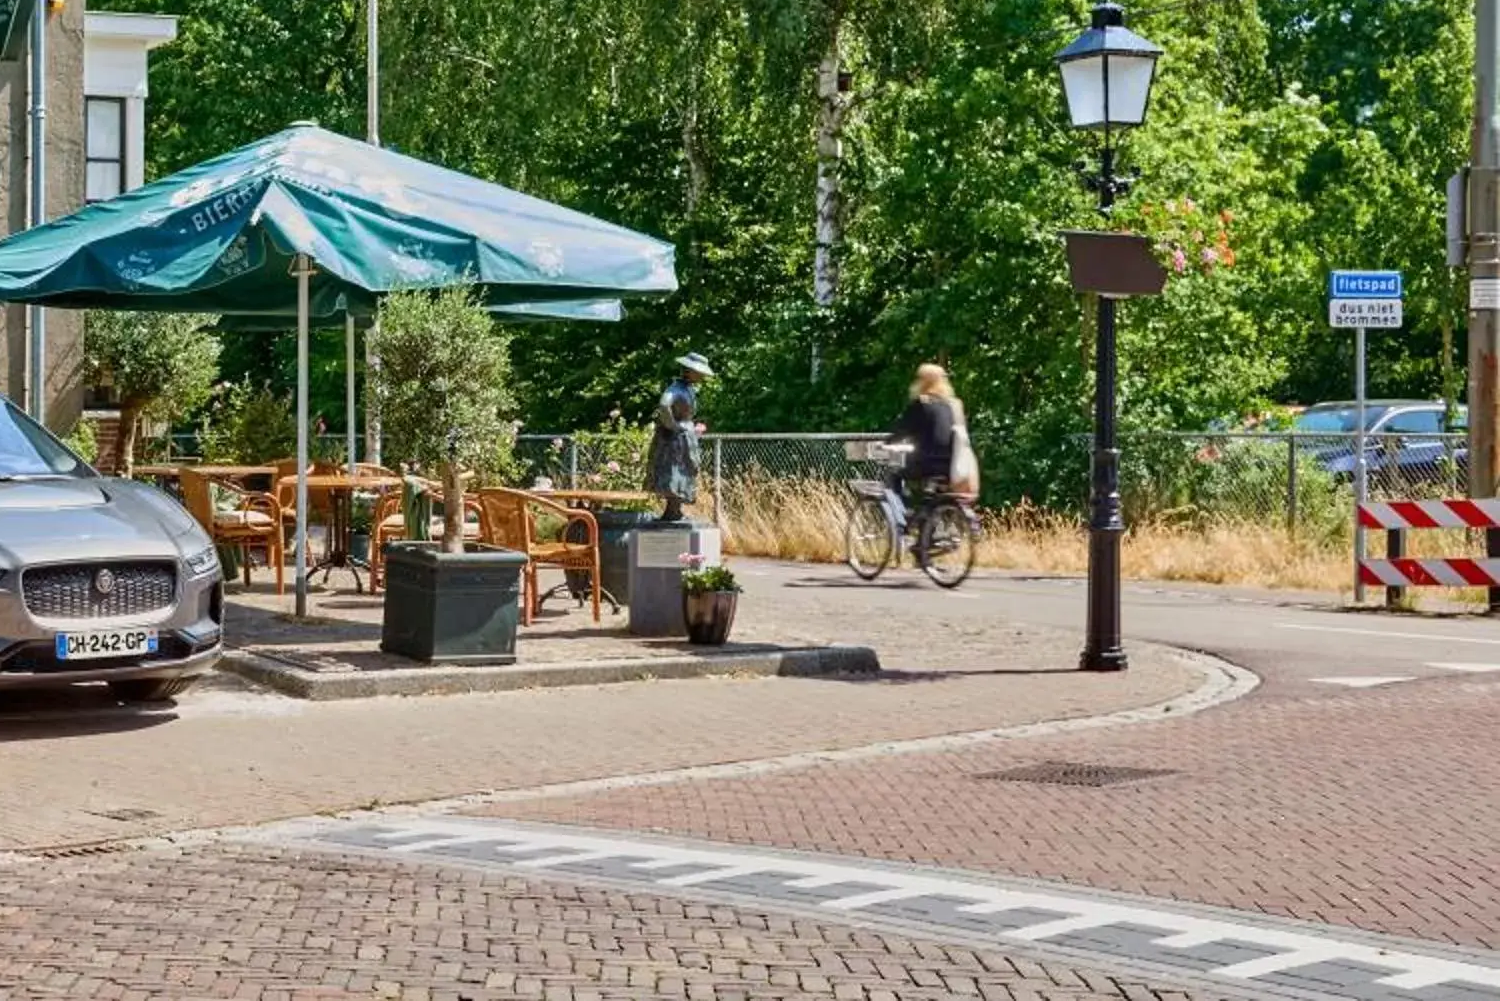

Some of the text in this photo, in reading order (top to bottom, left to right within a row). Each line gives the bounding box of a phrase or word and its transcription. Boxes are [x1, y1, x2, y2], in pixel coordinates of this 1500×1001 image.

[1339, 278, 1395, 291] fietspad
[1339, 303, 1394, 314] dus niet
